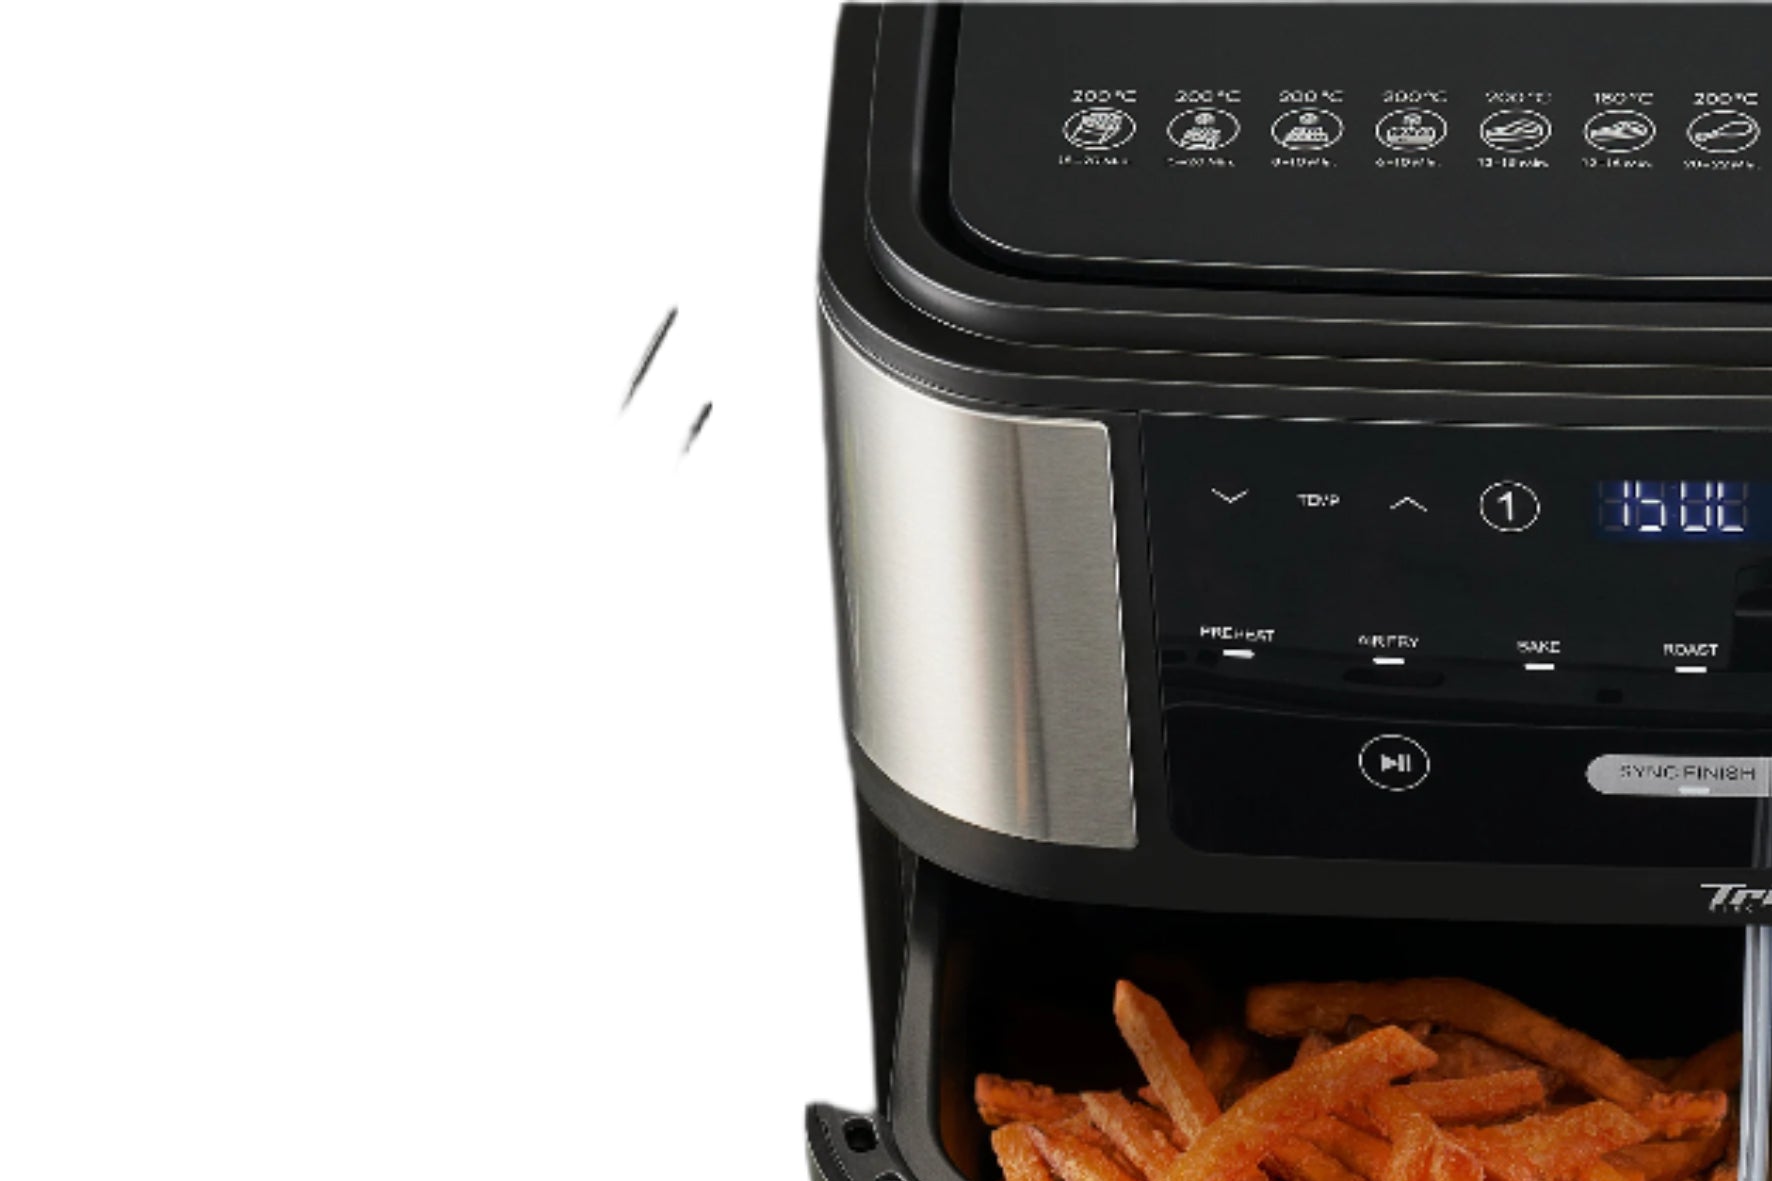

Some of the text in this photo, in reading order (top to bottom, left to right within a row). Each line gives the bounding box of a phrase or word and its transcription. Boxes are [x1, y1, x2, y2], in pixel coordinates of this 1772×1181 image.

[1497, 491, 1514, 521] 1
[1200, 625, 1276, 642] PREHEAT
[1516, 640, 1561, 653] BAKE
[1663, 643, 1719, 656] ROAST
[1620, 765, 1756, 782] SYNC FINISH
